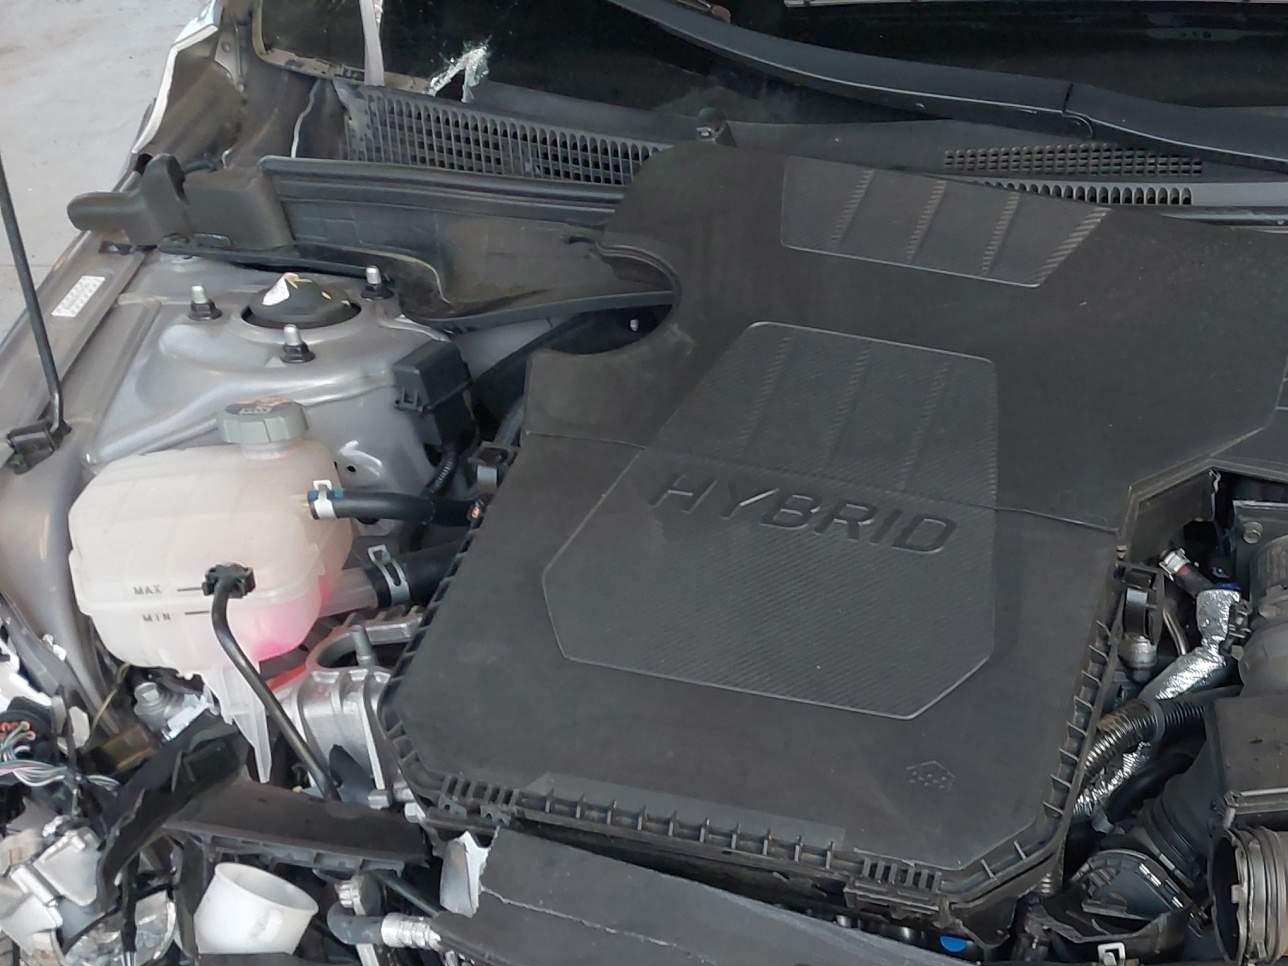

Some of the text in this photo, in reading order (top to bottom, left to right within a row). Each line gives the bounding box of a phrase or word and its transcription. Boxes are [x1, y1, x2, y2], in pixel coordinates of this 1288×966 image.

[649, 473, 956, 555] HYBRID
[133, 584, 162, 595] MAX
[142, 612, 172, 623] MIN
